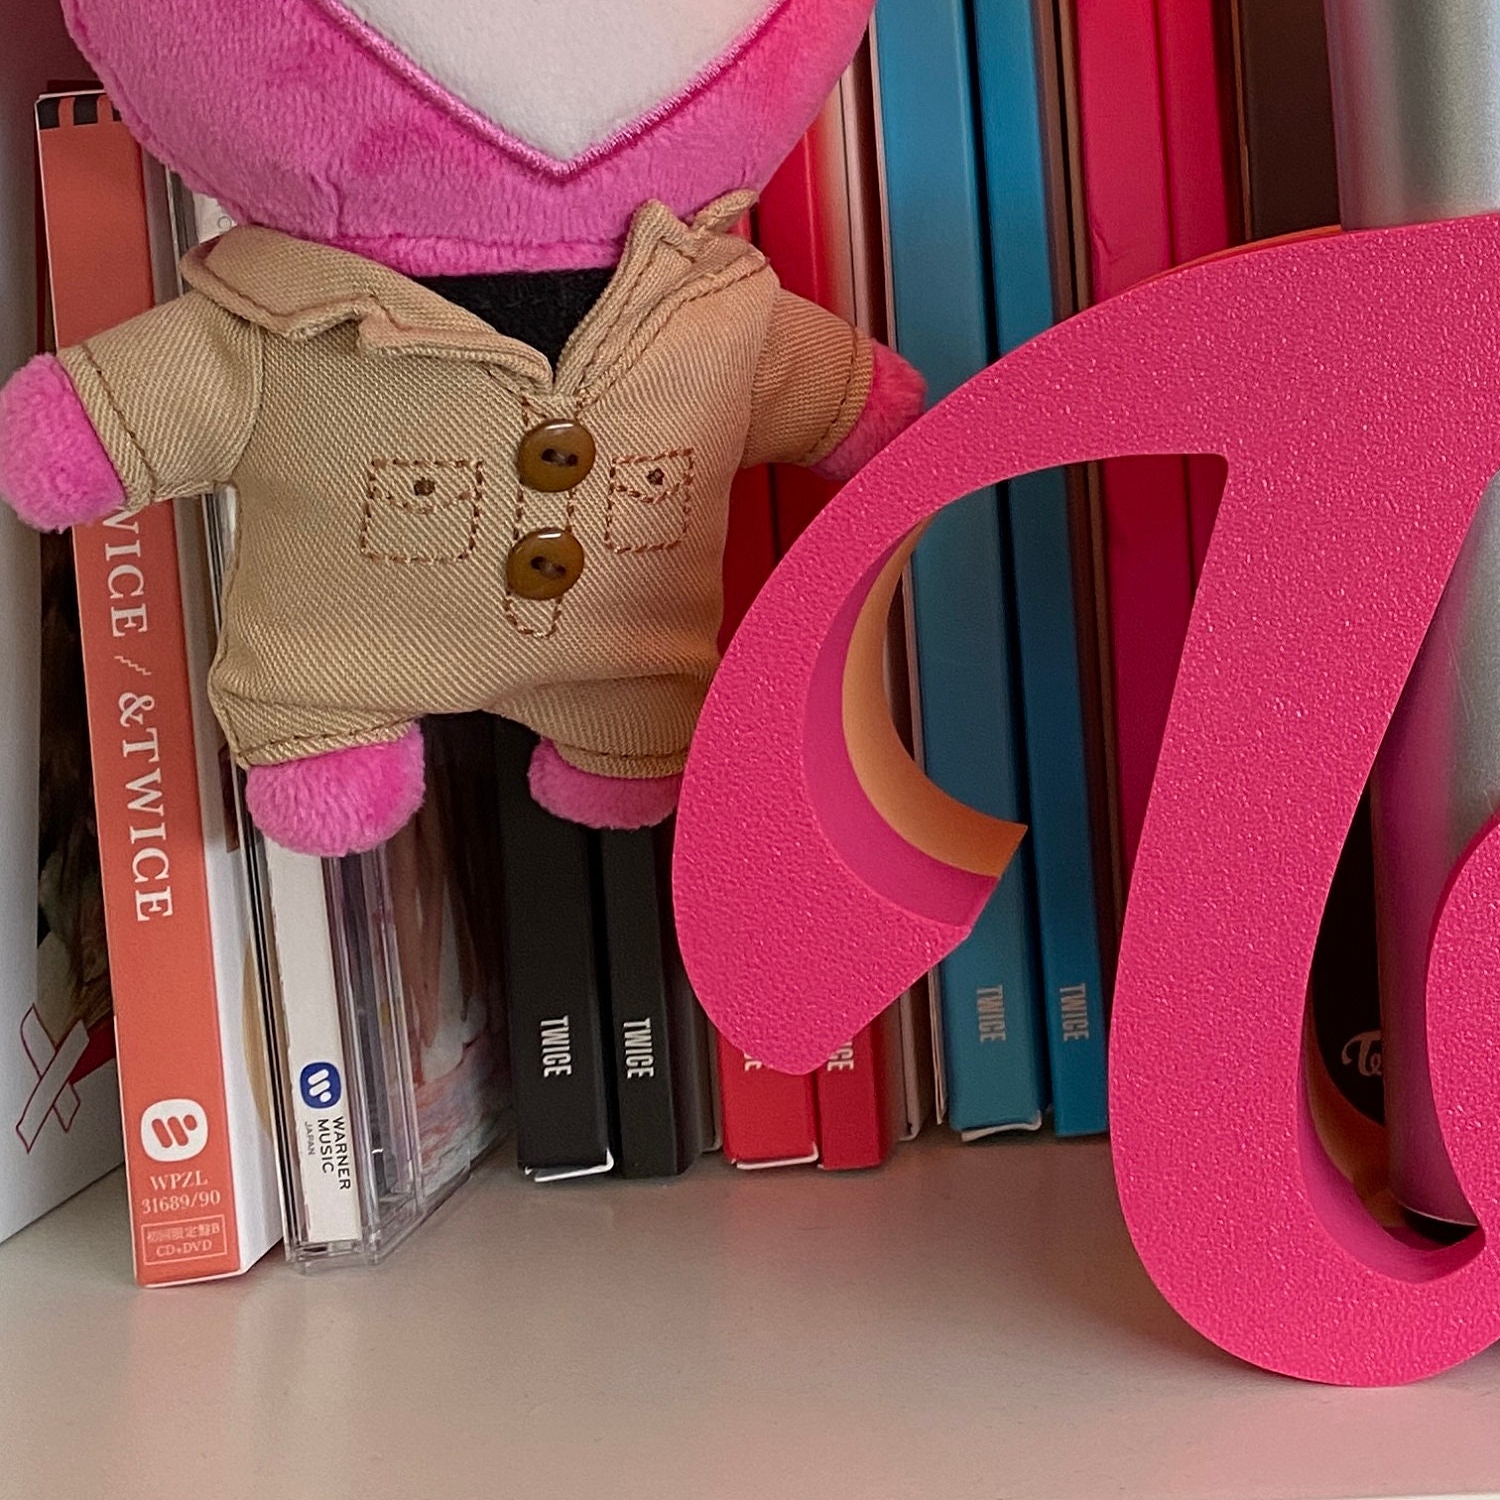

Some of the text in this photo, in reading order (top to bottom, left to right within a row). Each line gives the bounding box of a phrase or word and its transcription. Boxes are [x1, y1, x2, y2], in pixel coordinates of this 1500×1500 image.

[118, 690, 173, 922] &TWICE
[976, 984, 1006, 1043] TWICE
[1059, 982, 1090, 1042] TWICE
[540, 1015, 572, 1078] TWICE
[623, 1017, 654, 1080] TWICE
[304, 1120, 316, 1156] JAPAN
[317, 1118, 335, 1174] MUSIC
[332, 1115, 352, 1190] WARNER
[141, 1188, 221, 1215] 31689/90
[149, 1169, 209, 1191] WPZL
